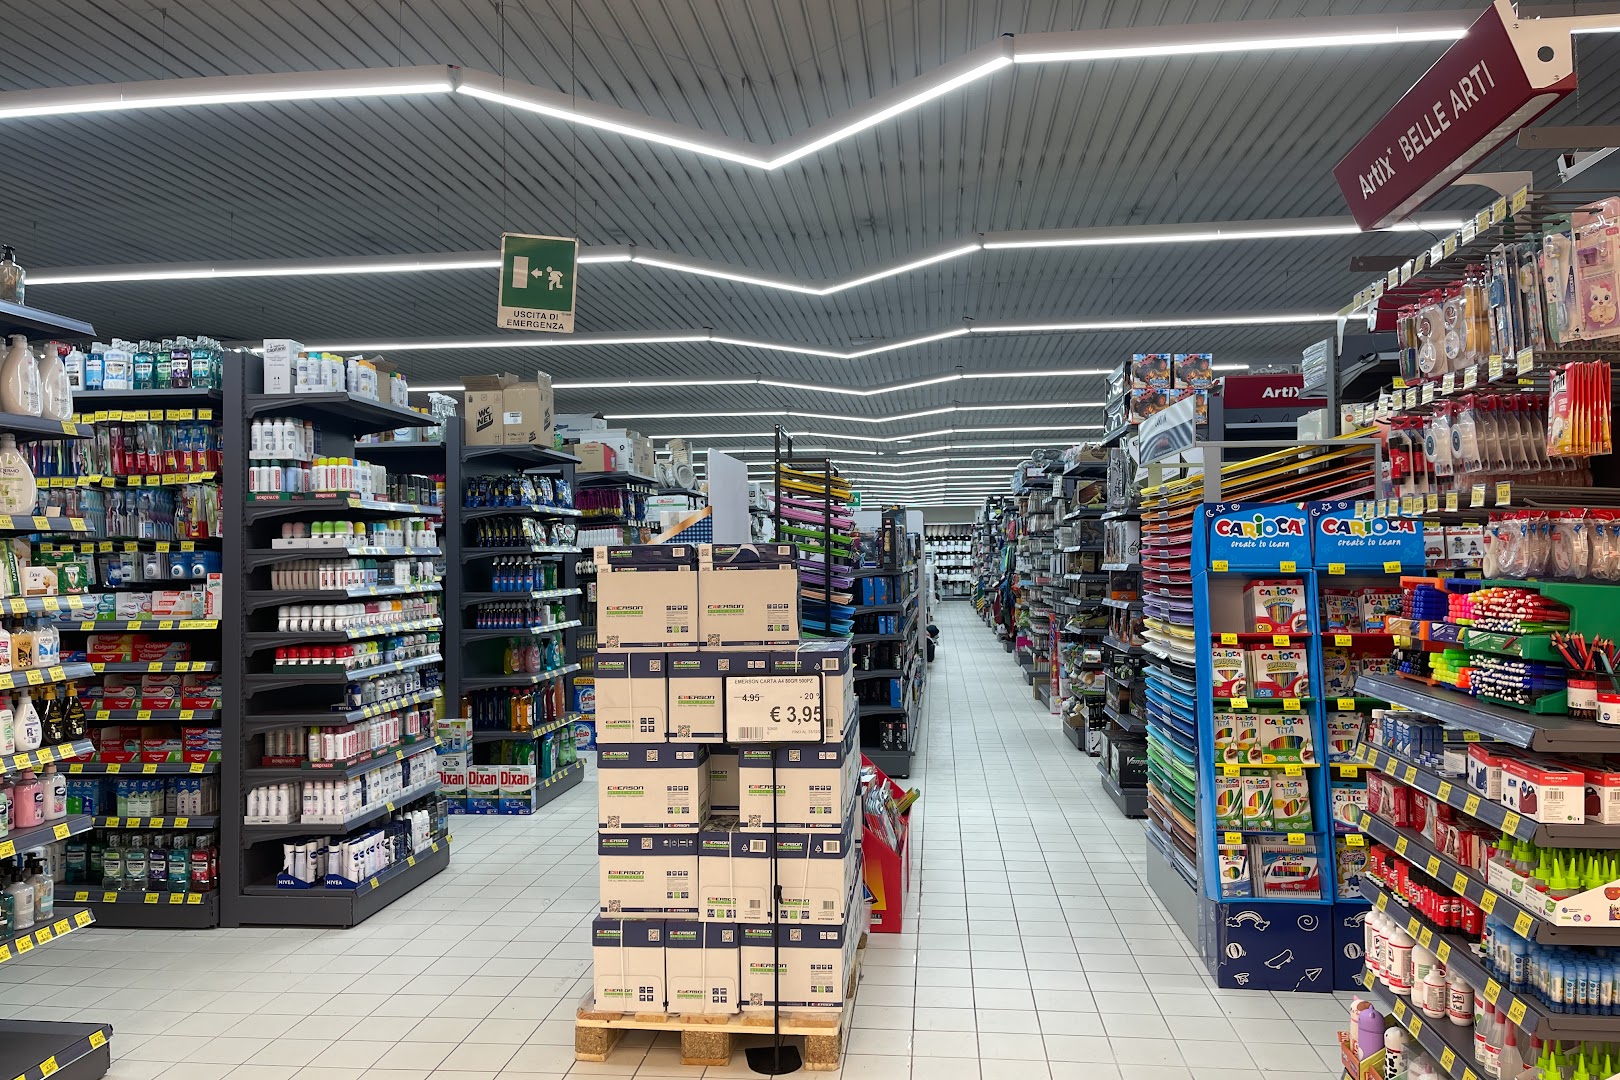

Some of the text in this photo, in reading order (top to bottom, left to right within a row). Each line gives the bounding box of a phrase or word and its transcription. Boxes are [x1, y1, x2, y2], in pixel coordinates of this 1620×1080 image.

[1398, 101, 1451, 163] BELLE
[1450, 59, 1496, 120] ARTI
[514, 310, 546, 320] USCITA
[506, 320, 564, 330] EMERGENZA
[478, 406, 490, 418] WC
[477, 413, 492, 426] NET
[742, 694, 760, 702] 4.95
[770, 706, 820, 726] € 3,95
[469, 772, 497, 785] Dixan
[501, 772, 529, 785] Dixan
